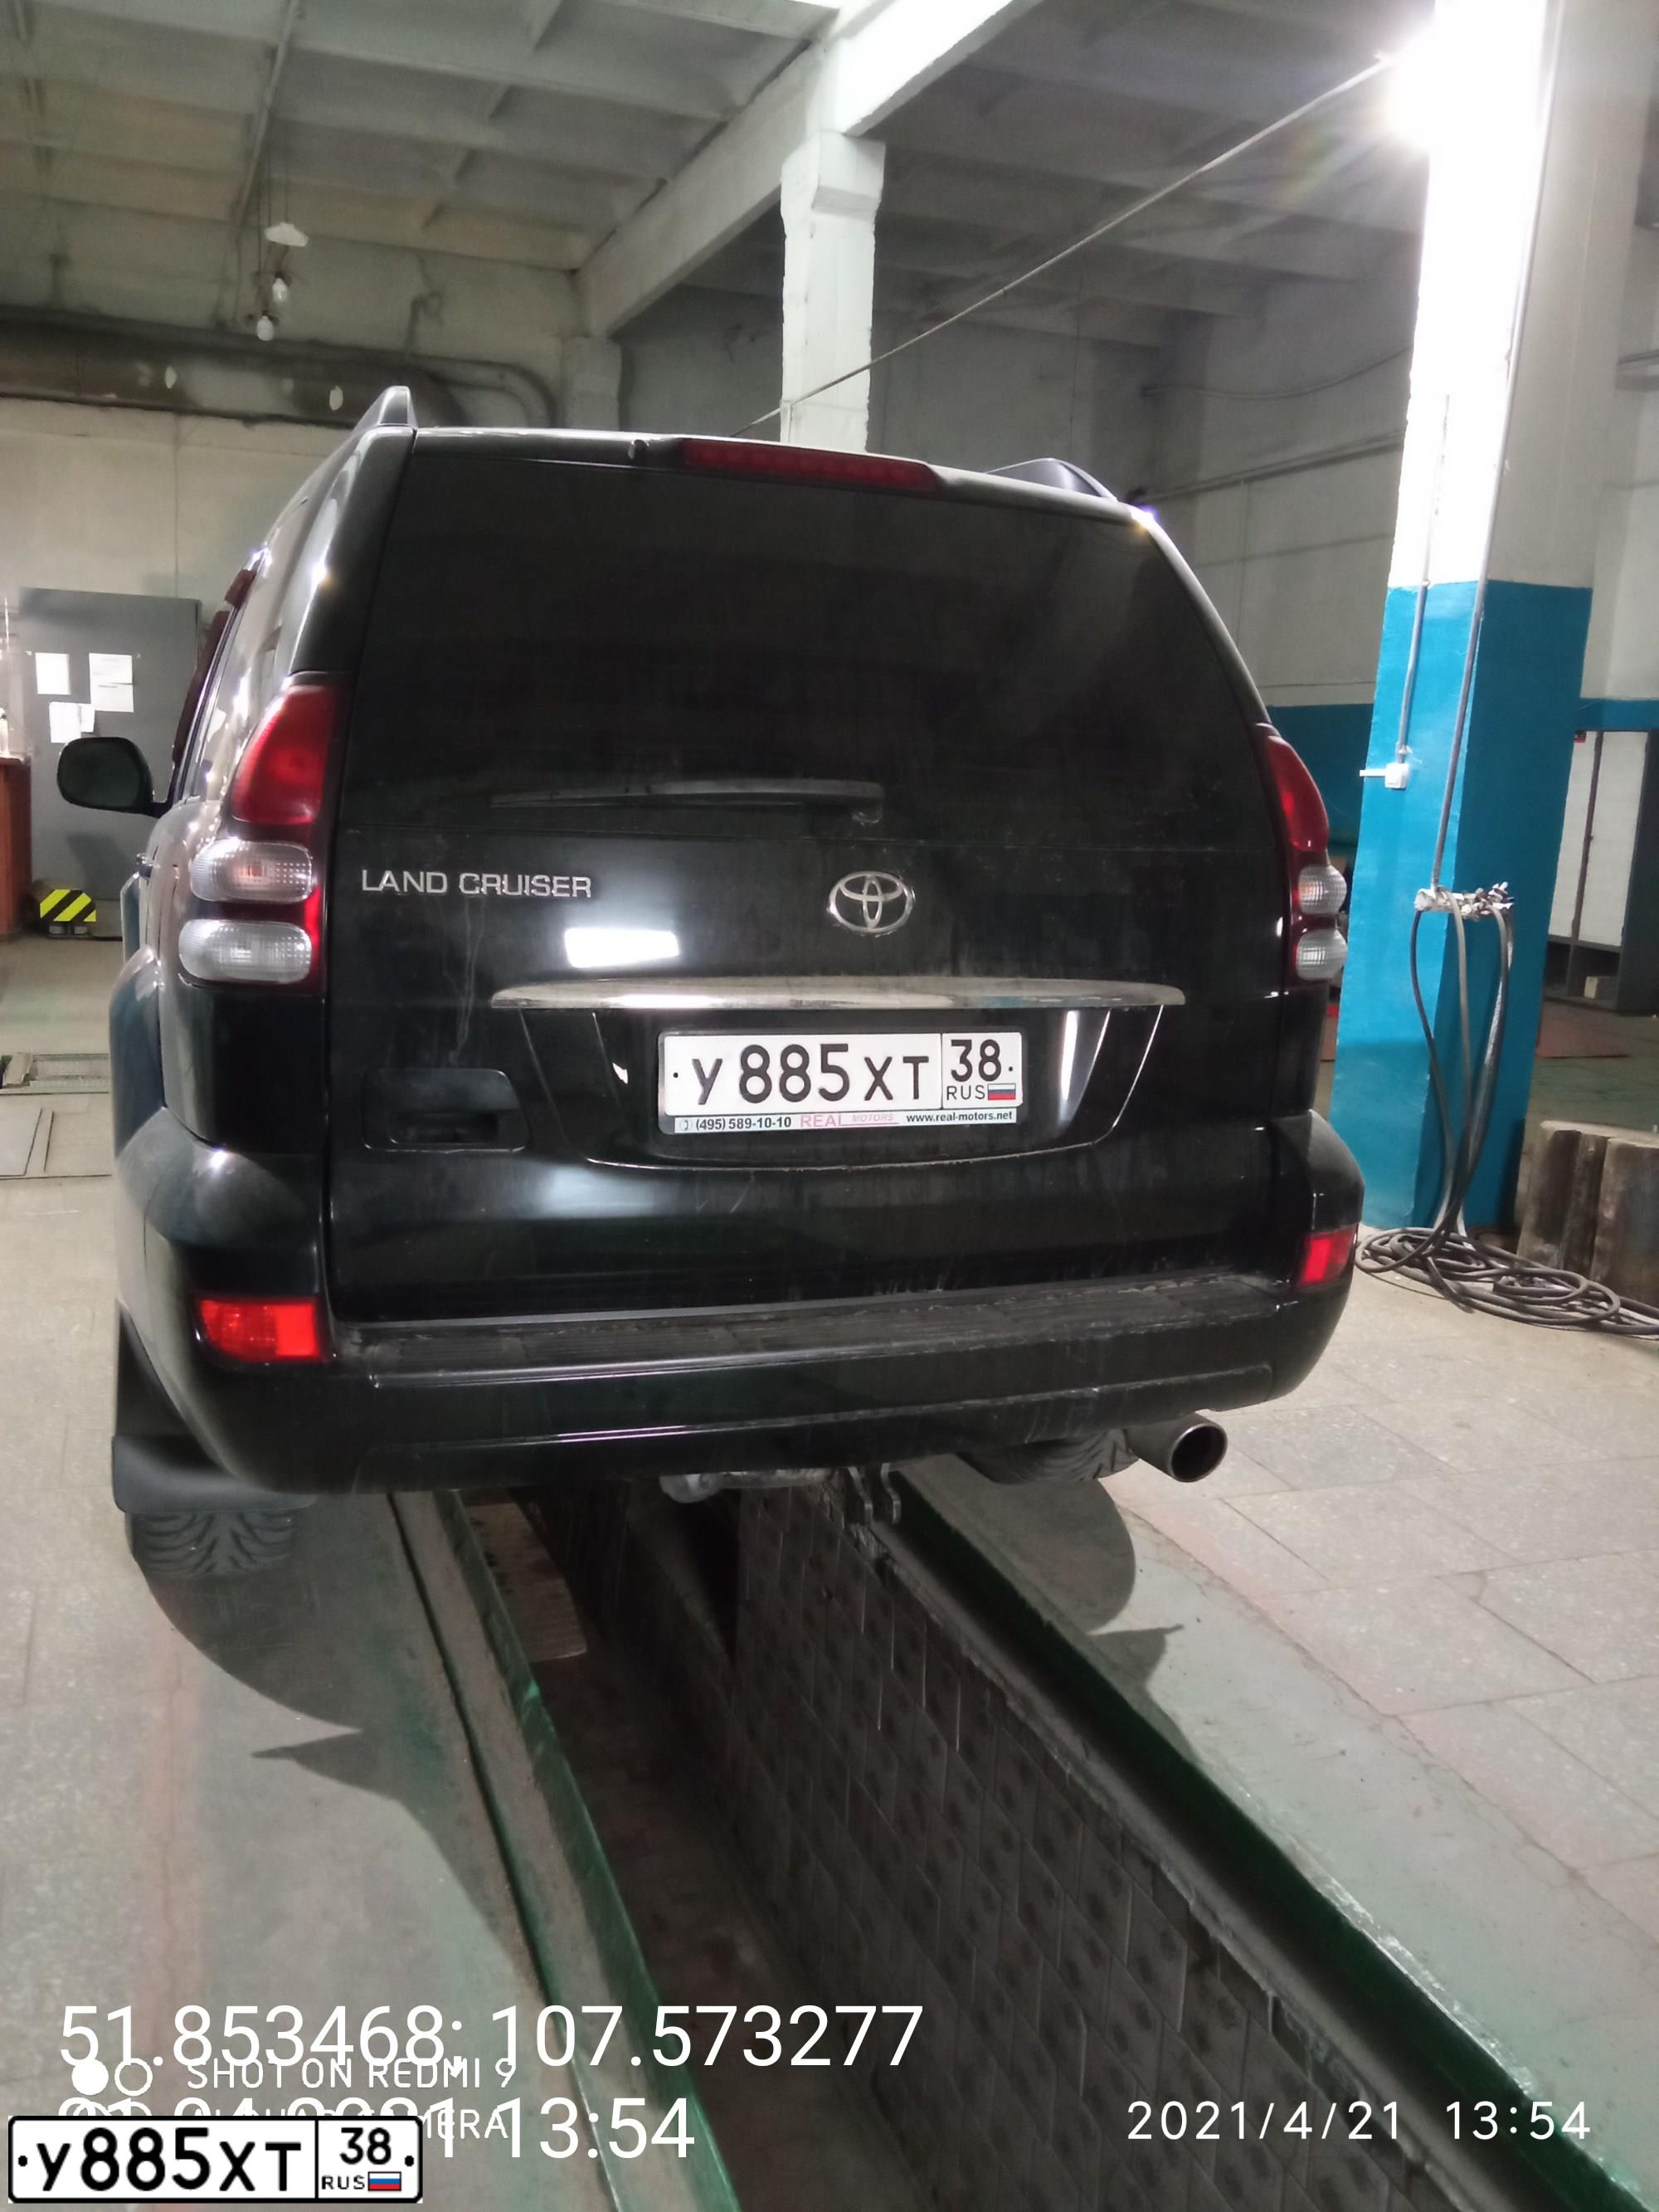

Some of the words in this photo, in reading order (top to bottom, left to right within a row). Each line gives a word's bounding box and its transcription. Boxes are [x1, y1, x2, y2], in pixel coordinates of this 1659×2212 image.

[362, 869, 448, 894] LAND
[458, 872, 592, 899] CRUISER
[951, 1039, 1002, 1082] 38
[946, 1084, 985, 1101] RUS
[695, 1117, 726, 1131] (495)
[728, 1116, 792, 1129] 589-10-10
[800, 1113, 843, 1128] REAL
[851, 1113, 894, 1123] MOTORS
[906, 1111, 1013, 1123] www.real-motors.net
